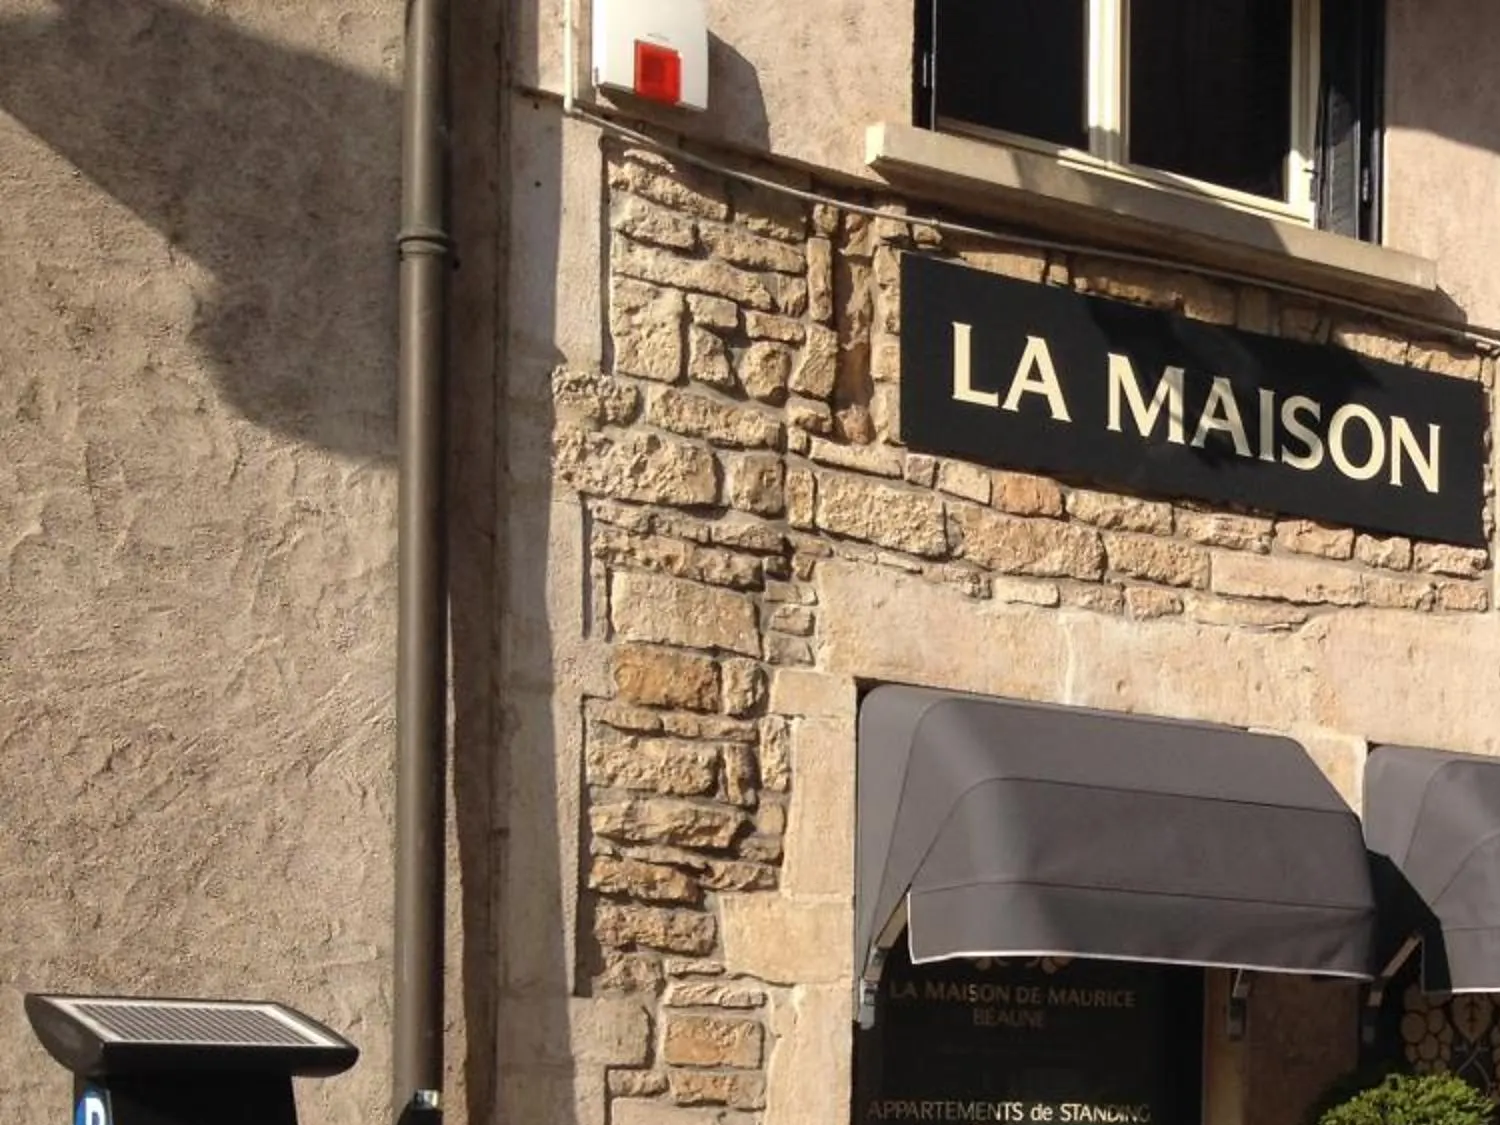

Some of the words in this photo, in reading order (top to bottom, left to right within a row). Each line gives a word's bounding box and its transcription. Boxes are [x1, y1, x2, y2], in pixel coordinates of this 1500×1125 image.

[951, 321, 1072, 424] LA
[1106, 351, 1443, 496] MAISON
[889, 980, 918, 1000] LA
[924, 980, 1010, 1005] MAISON
[1015, 985, 1043, 1005] DE
[1047, 986, 1138, 1009] MAURICE
[972, 1008, 1046, 1028] BEAUNE
[867, 1101, 1025, 1122] APPARTEMENTS
[1030, 1102, 1054, 1122] de
[1059, 1102, 1152, 1124] STANDING
